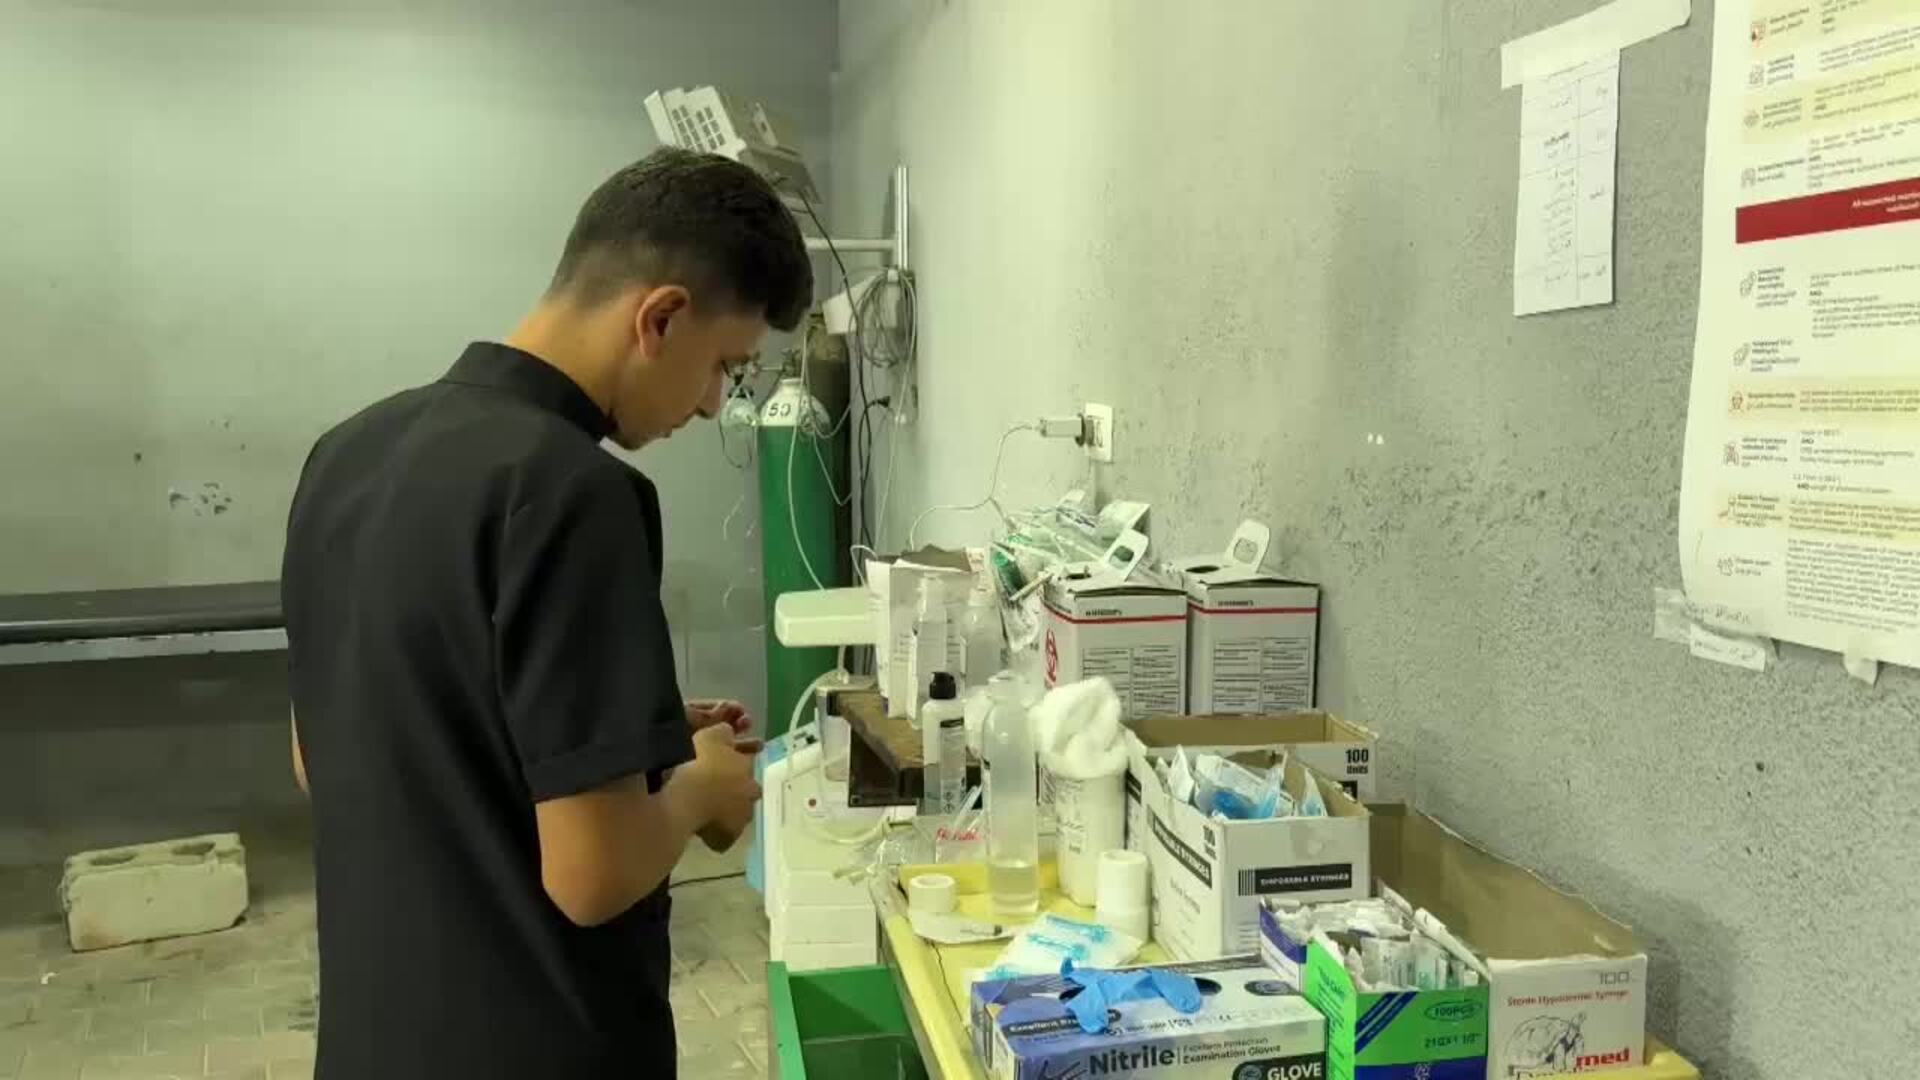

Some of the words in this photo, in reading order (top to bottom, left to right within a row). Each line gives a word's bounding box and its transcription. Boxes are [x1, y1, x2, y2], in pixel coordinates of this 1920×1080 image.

[768, 402, 791, 417] 50
[1345, 749, 1369, 763] 100
[1600, 971, 1630, 984] 100
[1089, 1045, 1175, 1075] Nitrile
[1183, 1049, 1246, 1064] Examination
[1247, 1045, 1281, 1056] Gloves
[1576, 1047, 1630, 1069] med
[1267, 1062, 1322, 1080] GLOVE
